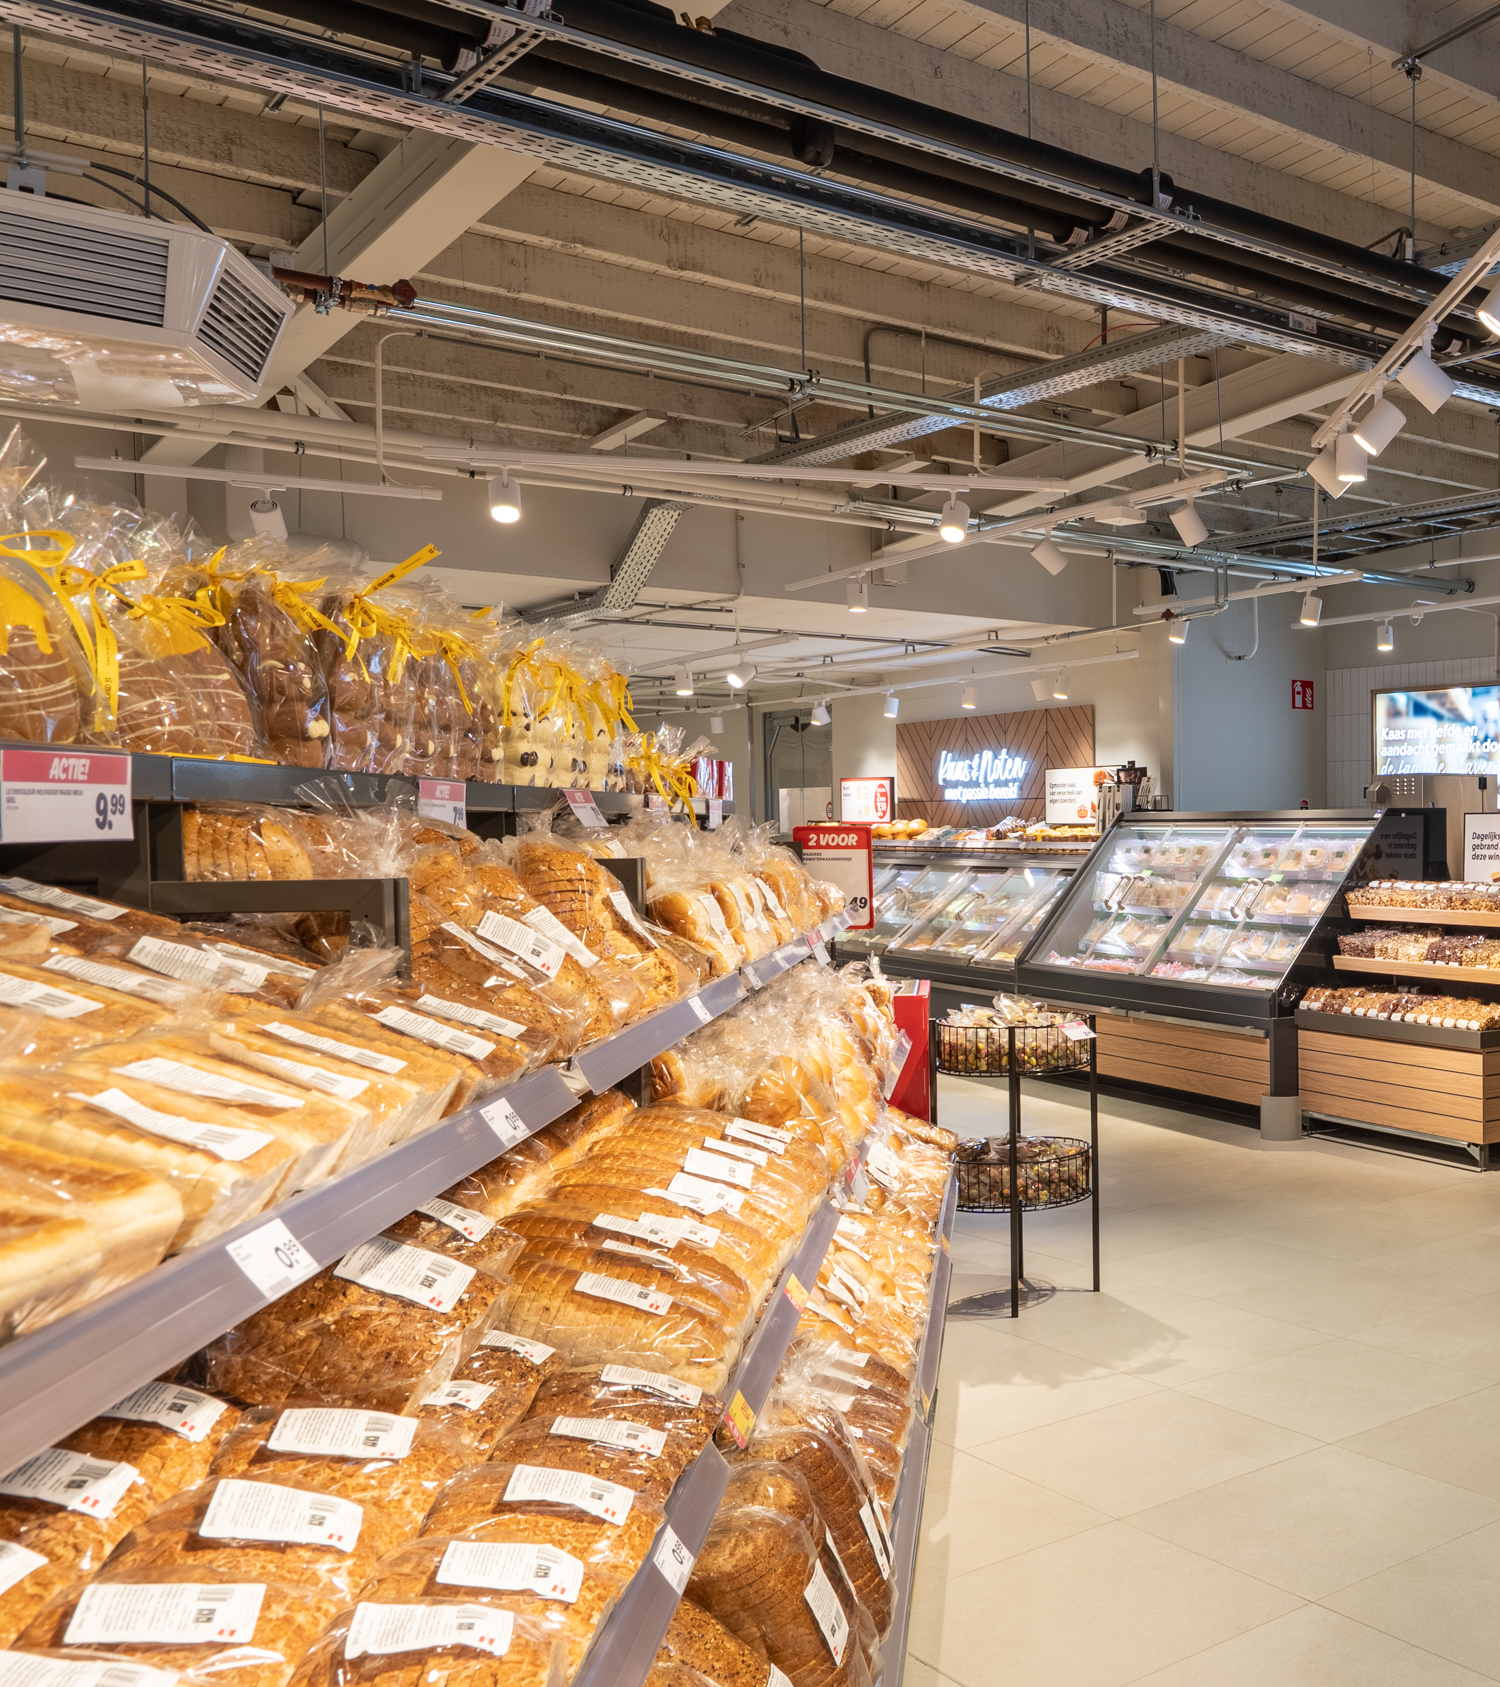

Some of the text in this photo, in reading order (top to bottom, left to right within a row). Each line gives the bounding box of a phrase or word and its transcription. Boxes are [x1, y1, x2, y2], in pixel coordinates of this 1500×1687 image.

[1381, 723, 1478, 741] Kaas met liefde en
[1381, 742, 1429, 757] aandacht
[1431, 740, 1480, 757] gemaakt
[49, 757, 90, 780] ACTIE!
[979, 748, 1027, 783] Noten
[1380, 758, 1395, 775] de
[95, 792, 125, 830] 9.99
[808, 833, 858, 846] 2 VOOR
[1472, 832, 1500, 841] Dagelijks
[1471, 841, 1499, 851] gebrand
